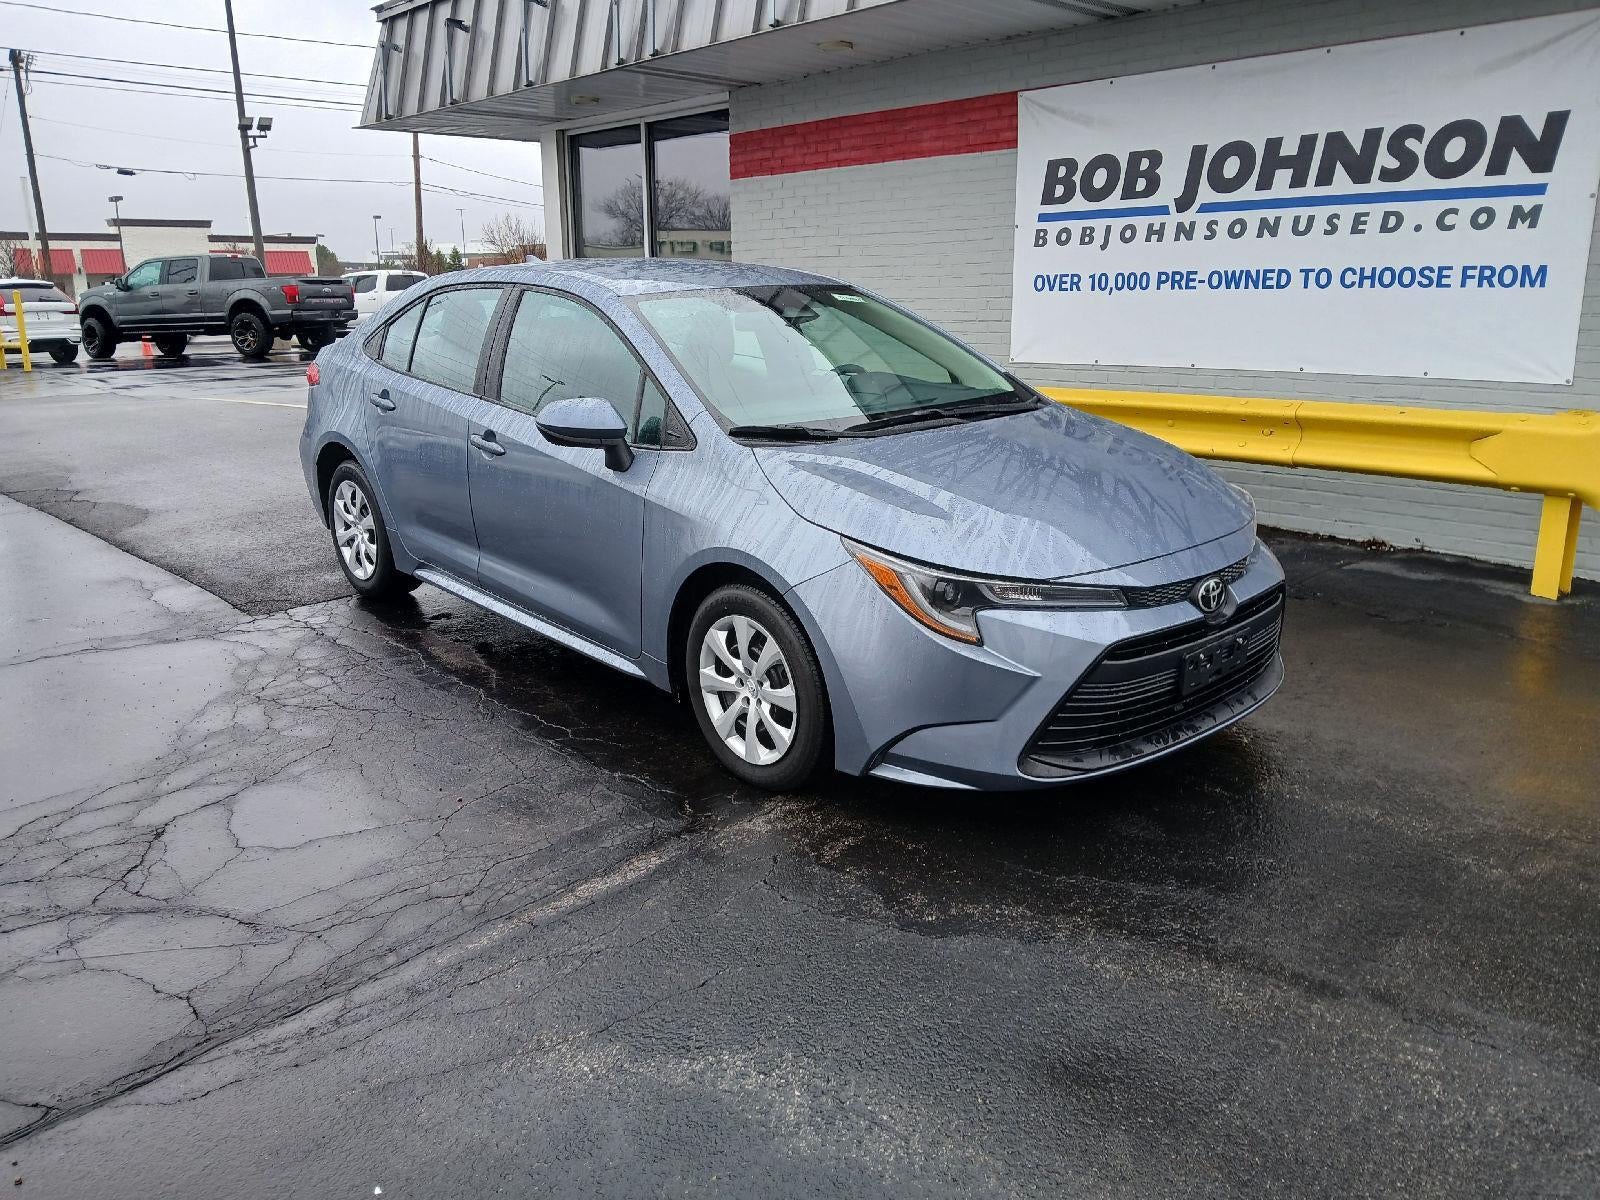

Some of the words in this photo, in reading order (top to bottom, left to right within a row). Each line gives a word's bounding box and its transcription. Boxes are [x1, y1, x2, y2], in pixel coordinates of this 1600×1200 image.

[1040, 149, 1163, 206] BOB
[1173, 109, 1572, 214] JOHNSON
[1033, 203, 1544, 250] BOBJOHNSONUSED.COM
[1033, 273, 1082, 293] OVER
[1088, 271, 1151, 296] 10,000
[1155, 267, 1292, 291] PRE-OWNED
[1299, 268, 1333, 290] TO
[1339, 265, 1455, 289] CHOOSE
[1459, 264, 1549, 289] FROM
